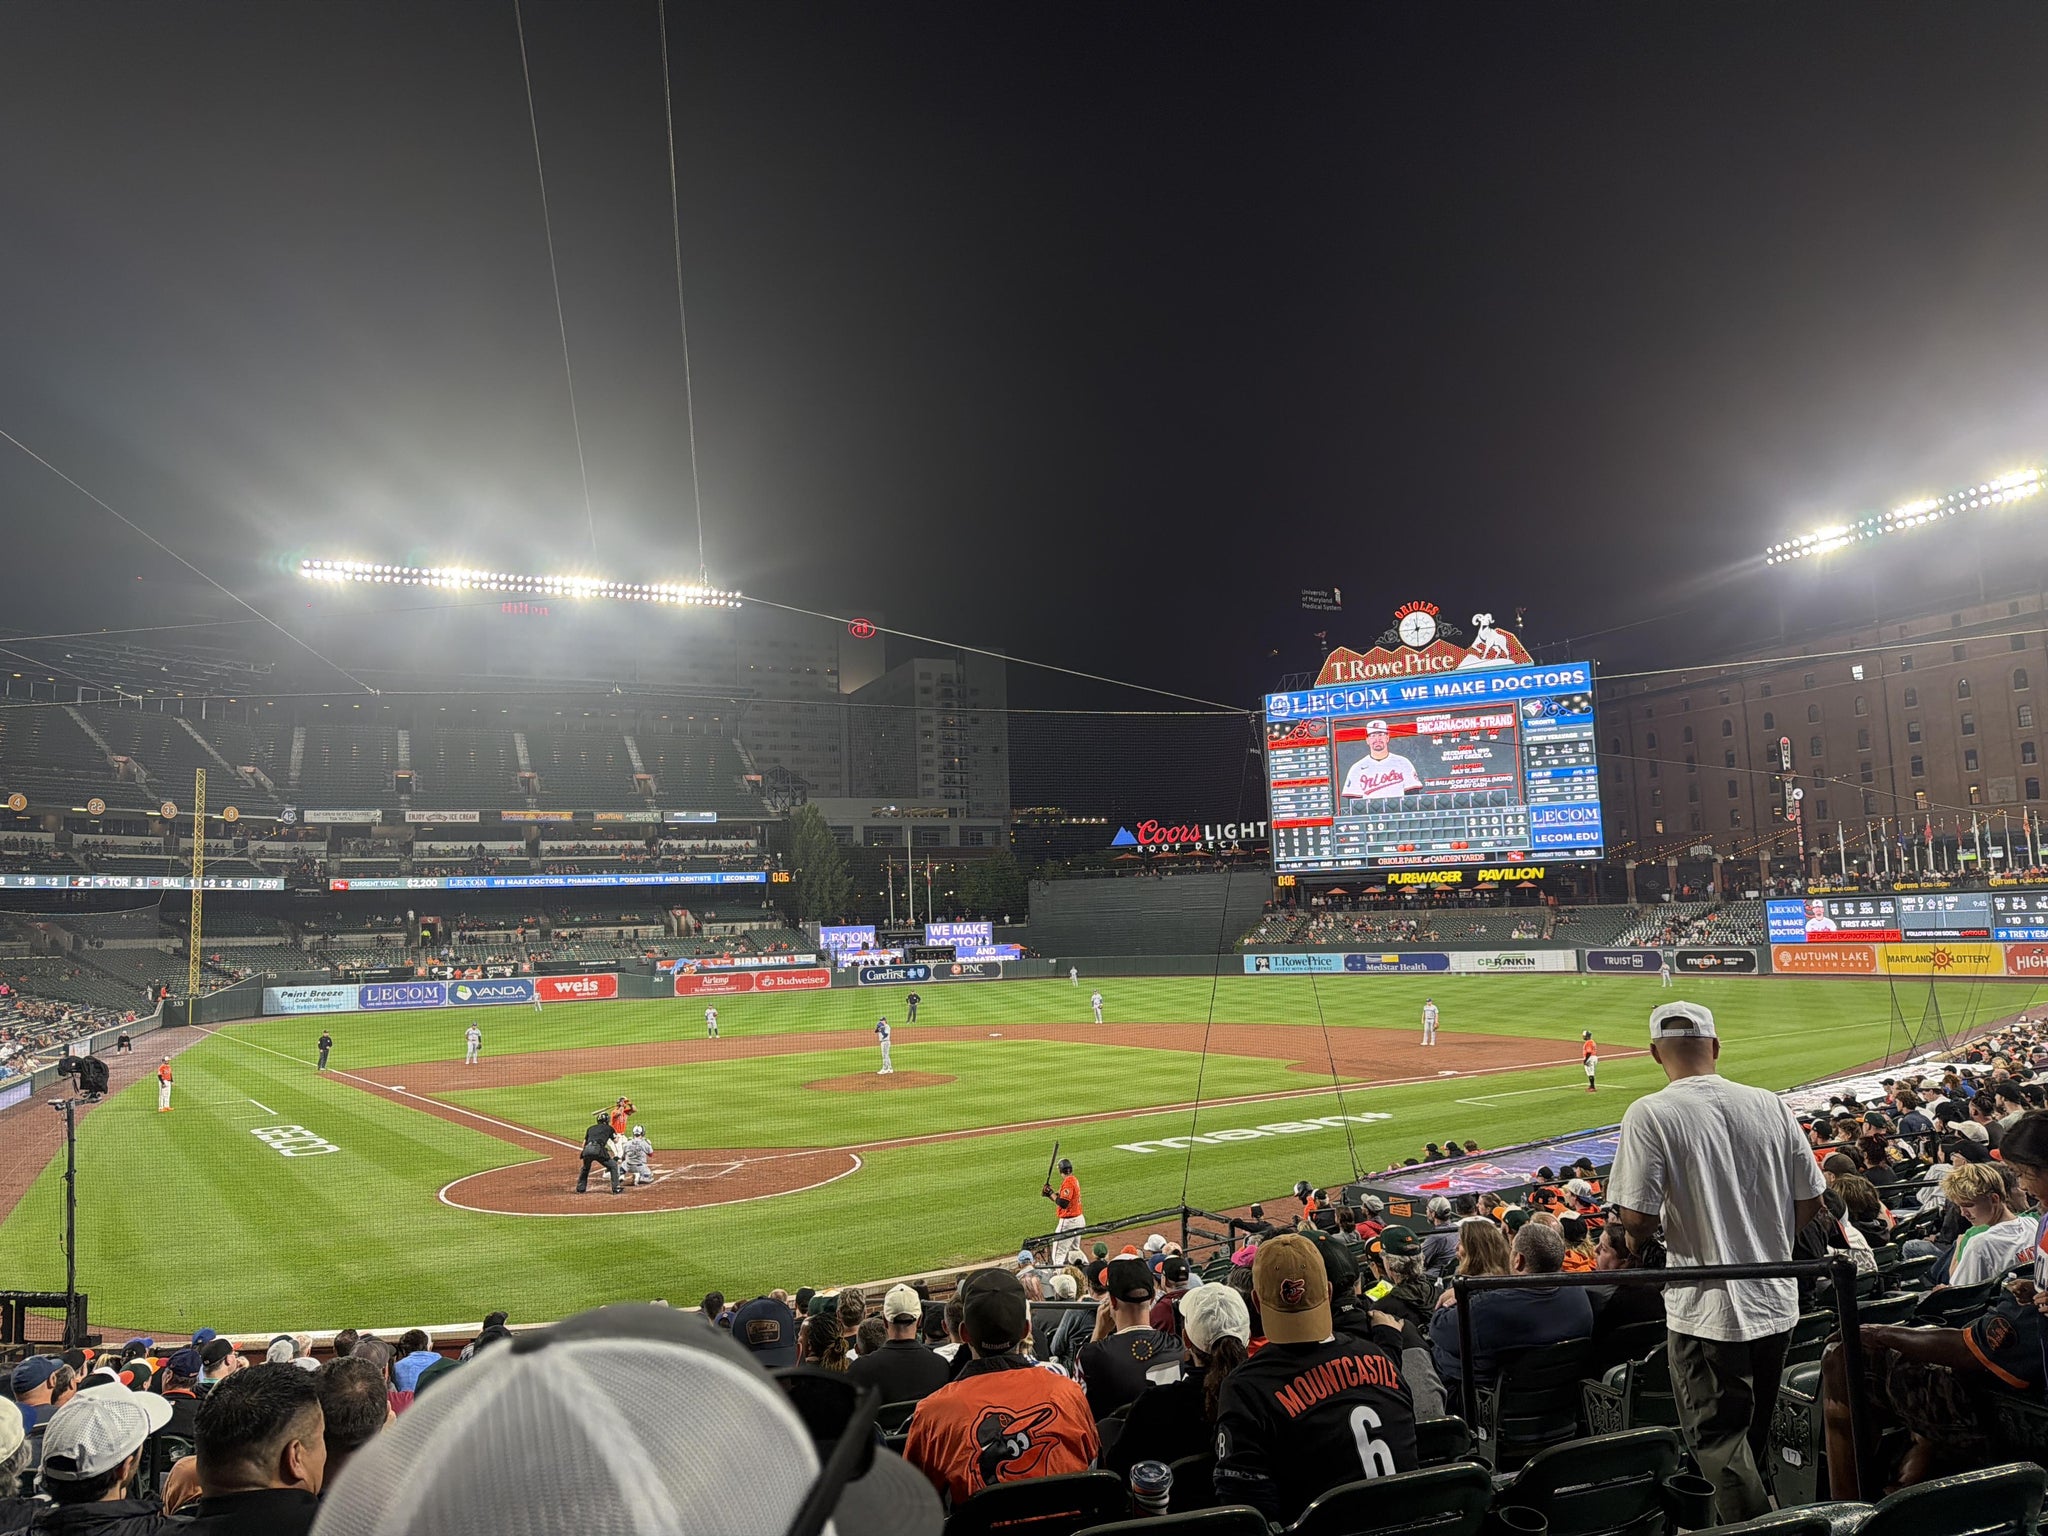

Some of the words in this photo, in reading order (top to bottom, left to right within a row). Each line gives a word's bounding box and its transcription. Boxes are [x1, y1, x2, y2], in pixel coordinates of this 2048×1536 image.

[1301, 589, 1328, 598] University
[1309, 596, 1333, 605] Maryland
[1302, 602, 1322, 610] Medical
[1394, 600, 1440, 619] ORIOLES
[1292, 688, 1390, 714] LECOM
[1401, 686, 1428, 700] WE
[1434, 680, 1486, 697] MAKE
[1491, 670, 1585, 692] DOCTORS
[1416, 714, 1514, 734] ENCARNACION-STRAND
[90, 802, 102, 811] 22
[163, 806, 175, 816] 33
[228, 810, 234, 819] 8
[283, 811, 294, 821] 42
[408, 813, 426, 821] ENJOY
[1532, 808, 1599, 823] LECOM
[1367, 823, 1374, 831] 3
[1469, 818, 1476, 826] 3
[1480, 817, 1488, 825] 3
[1491, 816, 1499, 824] 0
[1505, 816, 1513, 824] 4
[1517, 815, 1525, 823] 2
[1137, 819, 1202, 844] Coors
[1204, 821, 1268, 841] LIGHT
[1368, 834, 1374, 842] 1
[1470, 829, 1477, 837] 1
[1482, 828, 1487, 836] 1
[1492, 828, 1499, 836] 0
[1506, 827, 1514, 835] 2
[1518, 826, 1526, 835] 2
[1535, 831, 1599, 843] LECOM.EDU
[1137, 843, 1181, 853] ROOF
[1195, 840, 1240, 850] DECK
[1378, 857, 1406, 866] ORIOLE
[1405, 856, 1423, 864] PARK
[1430, 854, 1459, 863] CAMDEN
[1457, 853, 1485, 862] YARDS
[529, 877, 566, 886] DOCTORS,
[619, 876, 664, 884] PODIATRISTS
[664, 875, 679, 883] AND
[680, 875, 712, 883] DENTISTS
[772, 872, 790, 883] 0:06
[1278, 875, 1296, 886] 0:06
[1387, 870, 1463, 884] PUREWAGER
[1477, 867, 1545, 882] PAVILION
[23, 877, 36, 886] 28
[51, 877, 58, 886] 2
[108, 877, 129, 887] TOR
[135, 878, 143, 887] 3
[162, 878, 181, 888] BAL
[189, 878, 195, 887] 1
[209, 879, 216, 888] 2
[225, 879, 233, 888] 2
[242, 879, 249, 888] 0
[258, 880, 278, 889] 7:59
[350, 880, 379, 888] CURRENT
[406, 878, 438, 889] $2,200
[1893, 882, 1919, 891] Corona
[1988, 877, 2018, 887] Corona
[1807, 886, 1831, 895] Corona
[1917, 896, 1924, 904] 0
[1859, 907, 1874, 915] .320
[1902, 904, 1915, 912] DET
[1996, 903, 2006, 911] 19
[2012, 902, 2027, 910] 5-5
[1840, 920, 1860, 928] FIRST
[1860, 919, 1886, 928] AT-BAT
[2011, 917, 2021, 925] 10
[2034, 916, 2044, 924] 18
[929, 924, 951, 936] WE
[952, 923, 988, 936] MAKE
[1770, 928, 1805, 936] DOCTORS
[2009, 930, 2029, 938] TREY
[975, 946, 996, 956] AND
[1794, 951, 1839, 961] AUTUMN
[1841, 951, 1869, 961] LAKE
[734, 956, 759, 966] BIRD
[760, 955, 787, 965] BATH
[1603, 956, 1631, 966] TRUIST
[1887, 955, 1932, 964] MARYLAND
[1950, 955, 1991, 964] LOTTERY
[2016, 955, 2048, 971] HIGH
[962, 963, 984, 974] PNC
[1366, 963, 1399, 972] MedStar
[1400, 962, 1427, 971] Health
[866, 968, 906, 982] CareFirst
[553, 978, 599, 993] weis
[702, 976, 729, 986] Airtemp
[776, 976, 825, 986] Budweiser
[309, 990, 345, 998] Breeze
[366, 986, 438, 1002] LECOM
[472, 985, 526, 996] VANDA
[1274, 1354, 1400, 1419] MOUNTCASTLE
[1350, 1405, 1397, 1480] 6
[1786, 1450, 1797, 1461] 17
